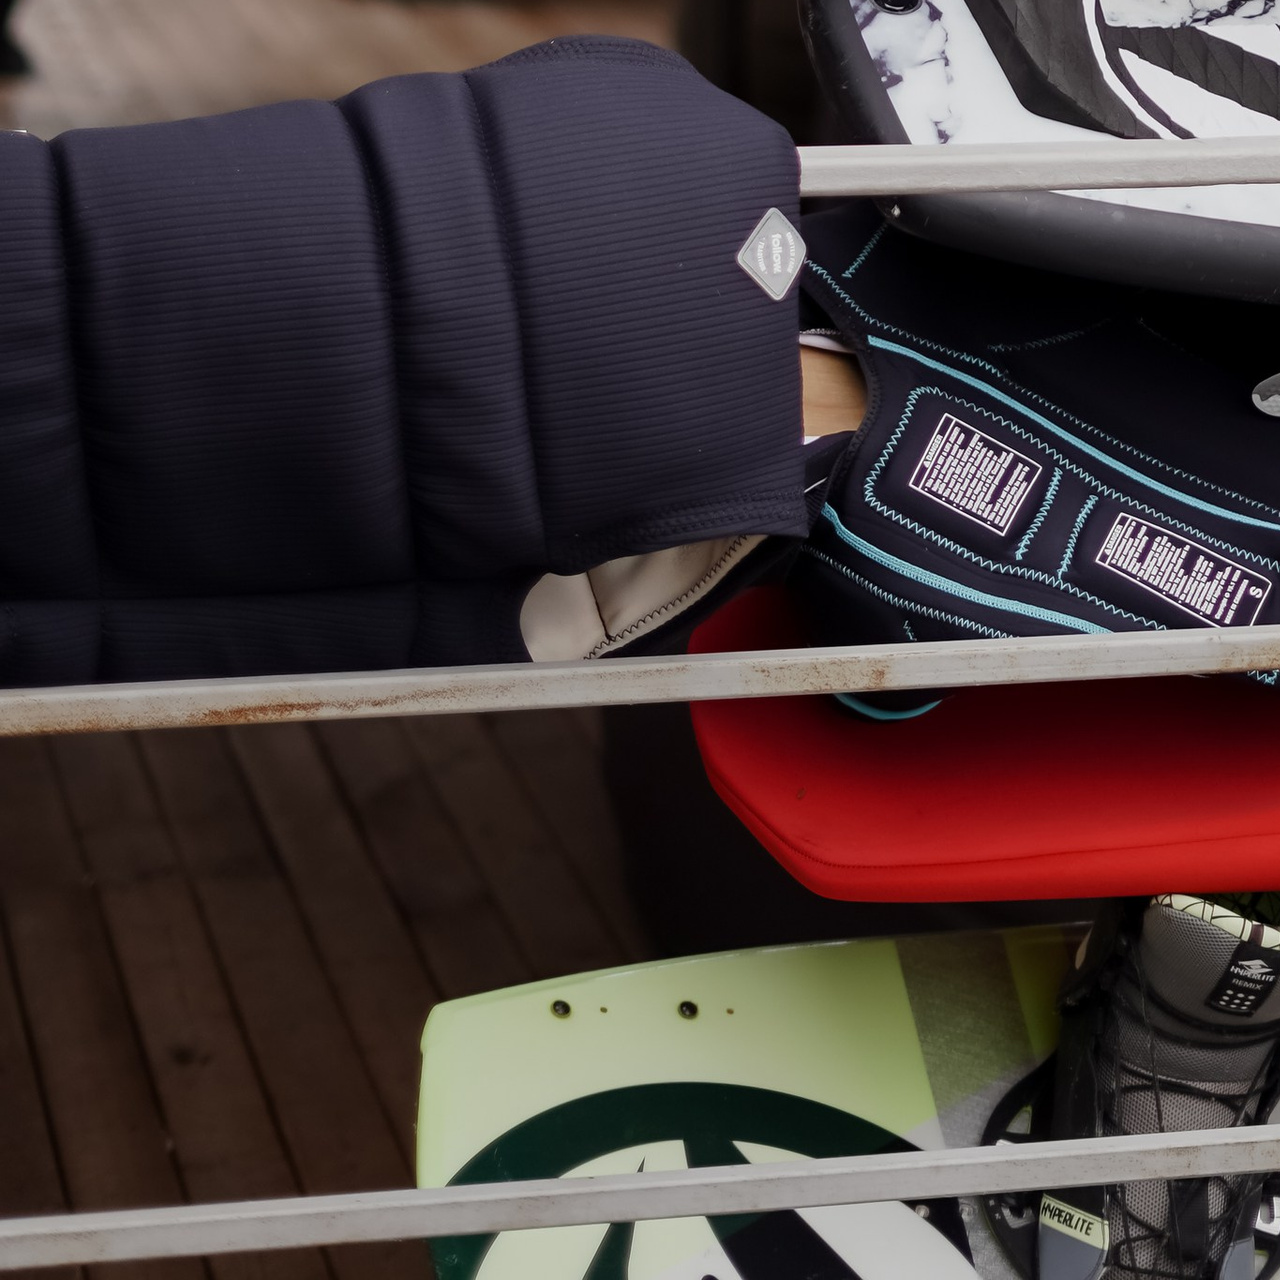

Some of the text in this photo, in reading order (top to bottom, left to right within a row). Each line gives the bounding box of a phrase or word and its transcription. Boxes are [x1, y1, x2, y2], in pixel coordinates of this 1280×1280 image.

[924, 433, 943, 461] DANGER
[1105, 523, 1123, 550] DANGER
[1250, 586, 1263, 599] S
[1229, 965, 1276, 982] HYPERLITE
[1232, 978, 1263, 990] REMIX
[1041, 1201, 1095, 1236] HYPERLITE
